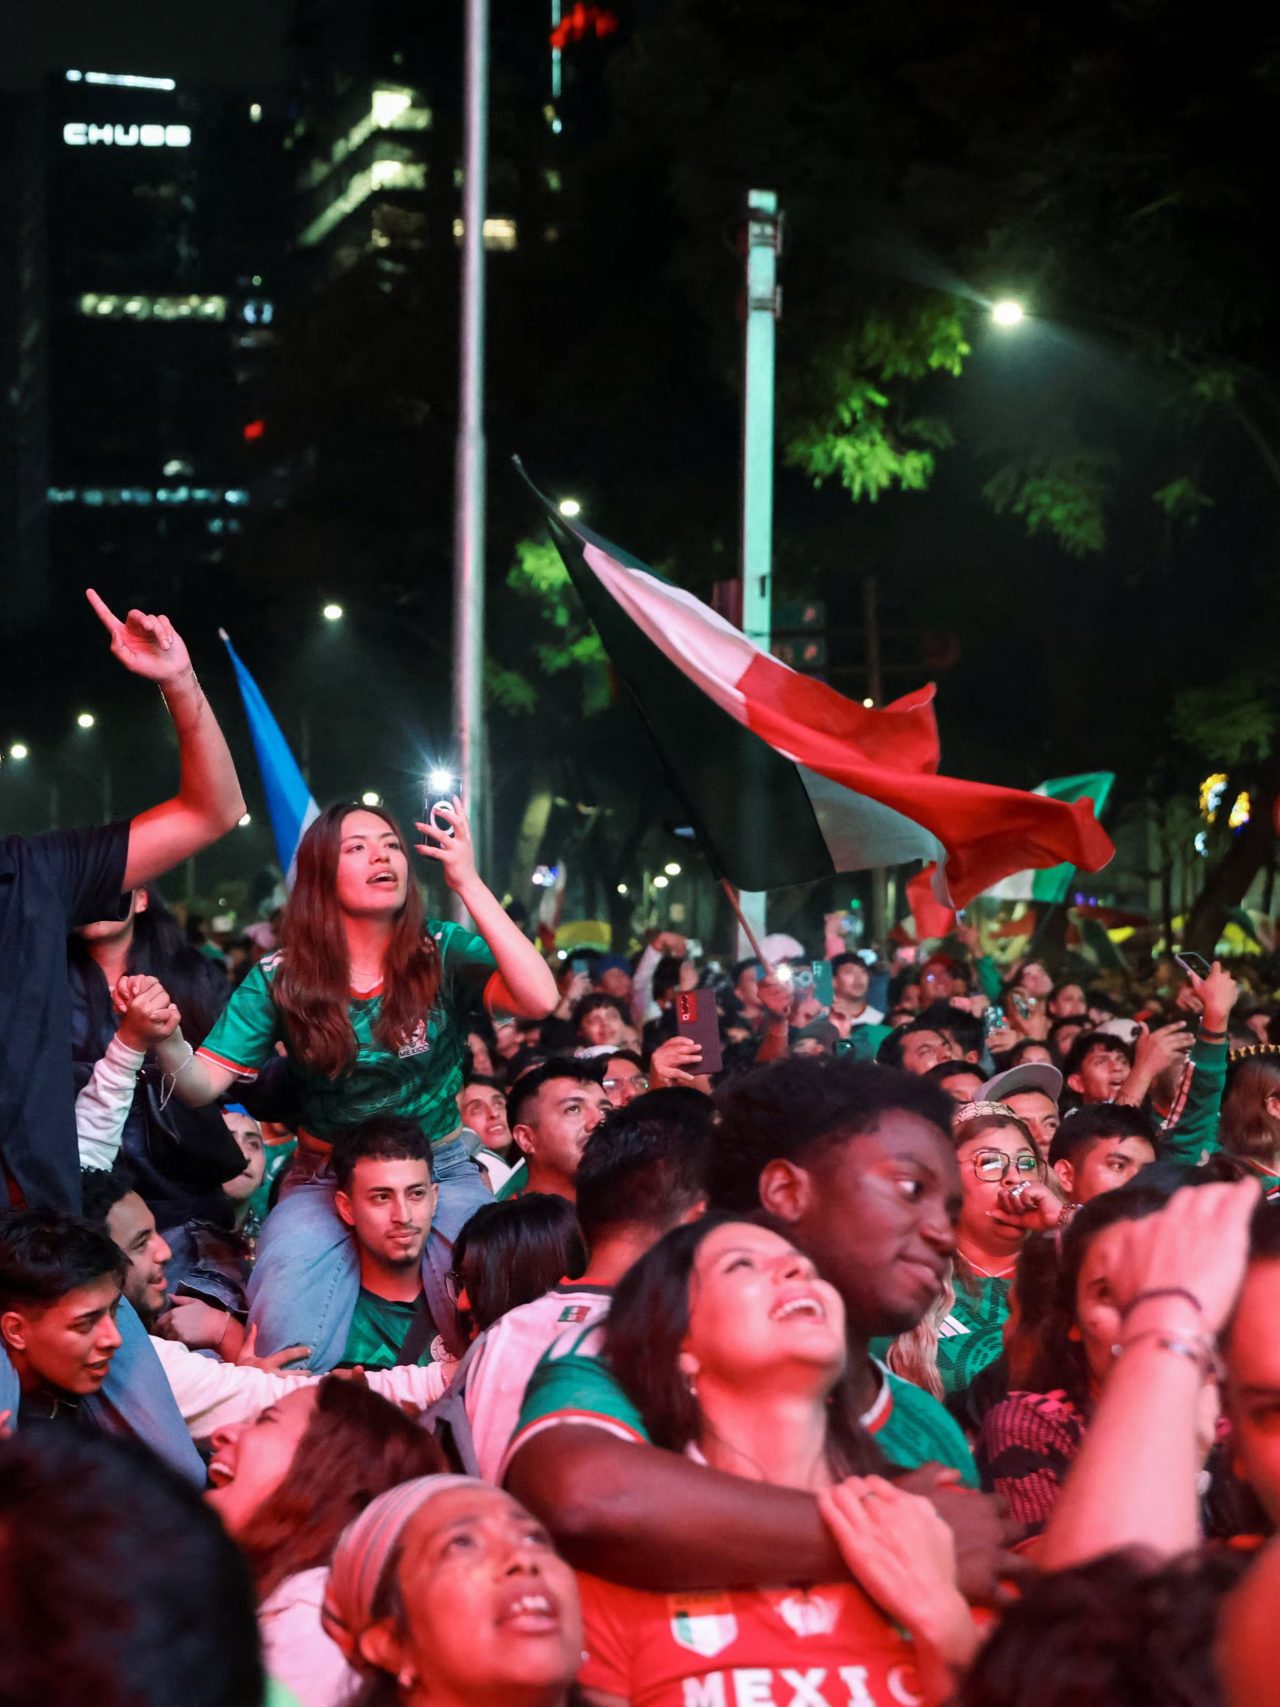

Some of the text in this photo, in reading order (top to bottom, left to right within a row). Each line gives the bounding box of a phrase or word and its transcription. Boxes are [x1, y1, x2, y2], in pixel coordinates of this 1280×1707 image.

[63, 122, 192, 148] CHUBB
[399, 1044, 429, 1057] MEXICO
[681, 1665, 924, 1707] MEXIC
